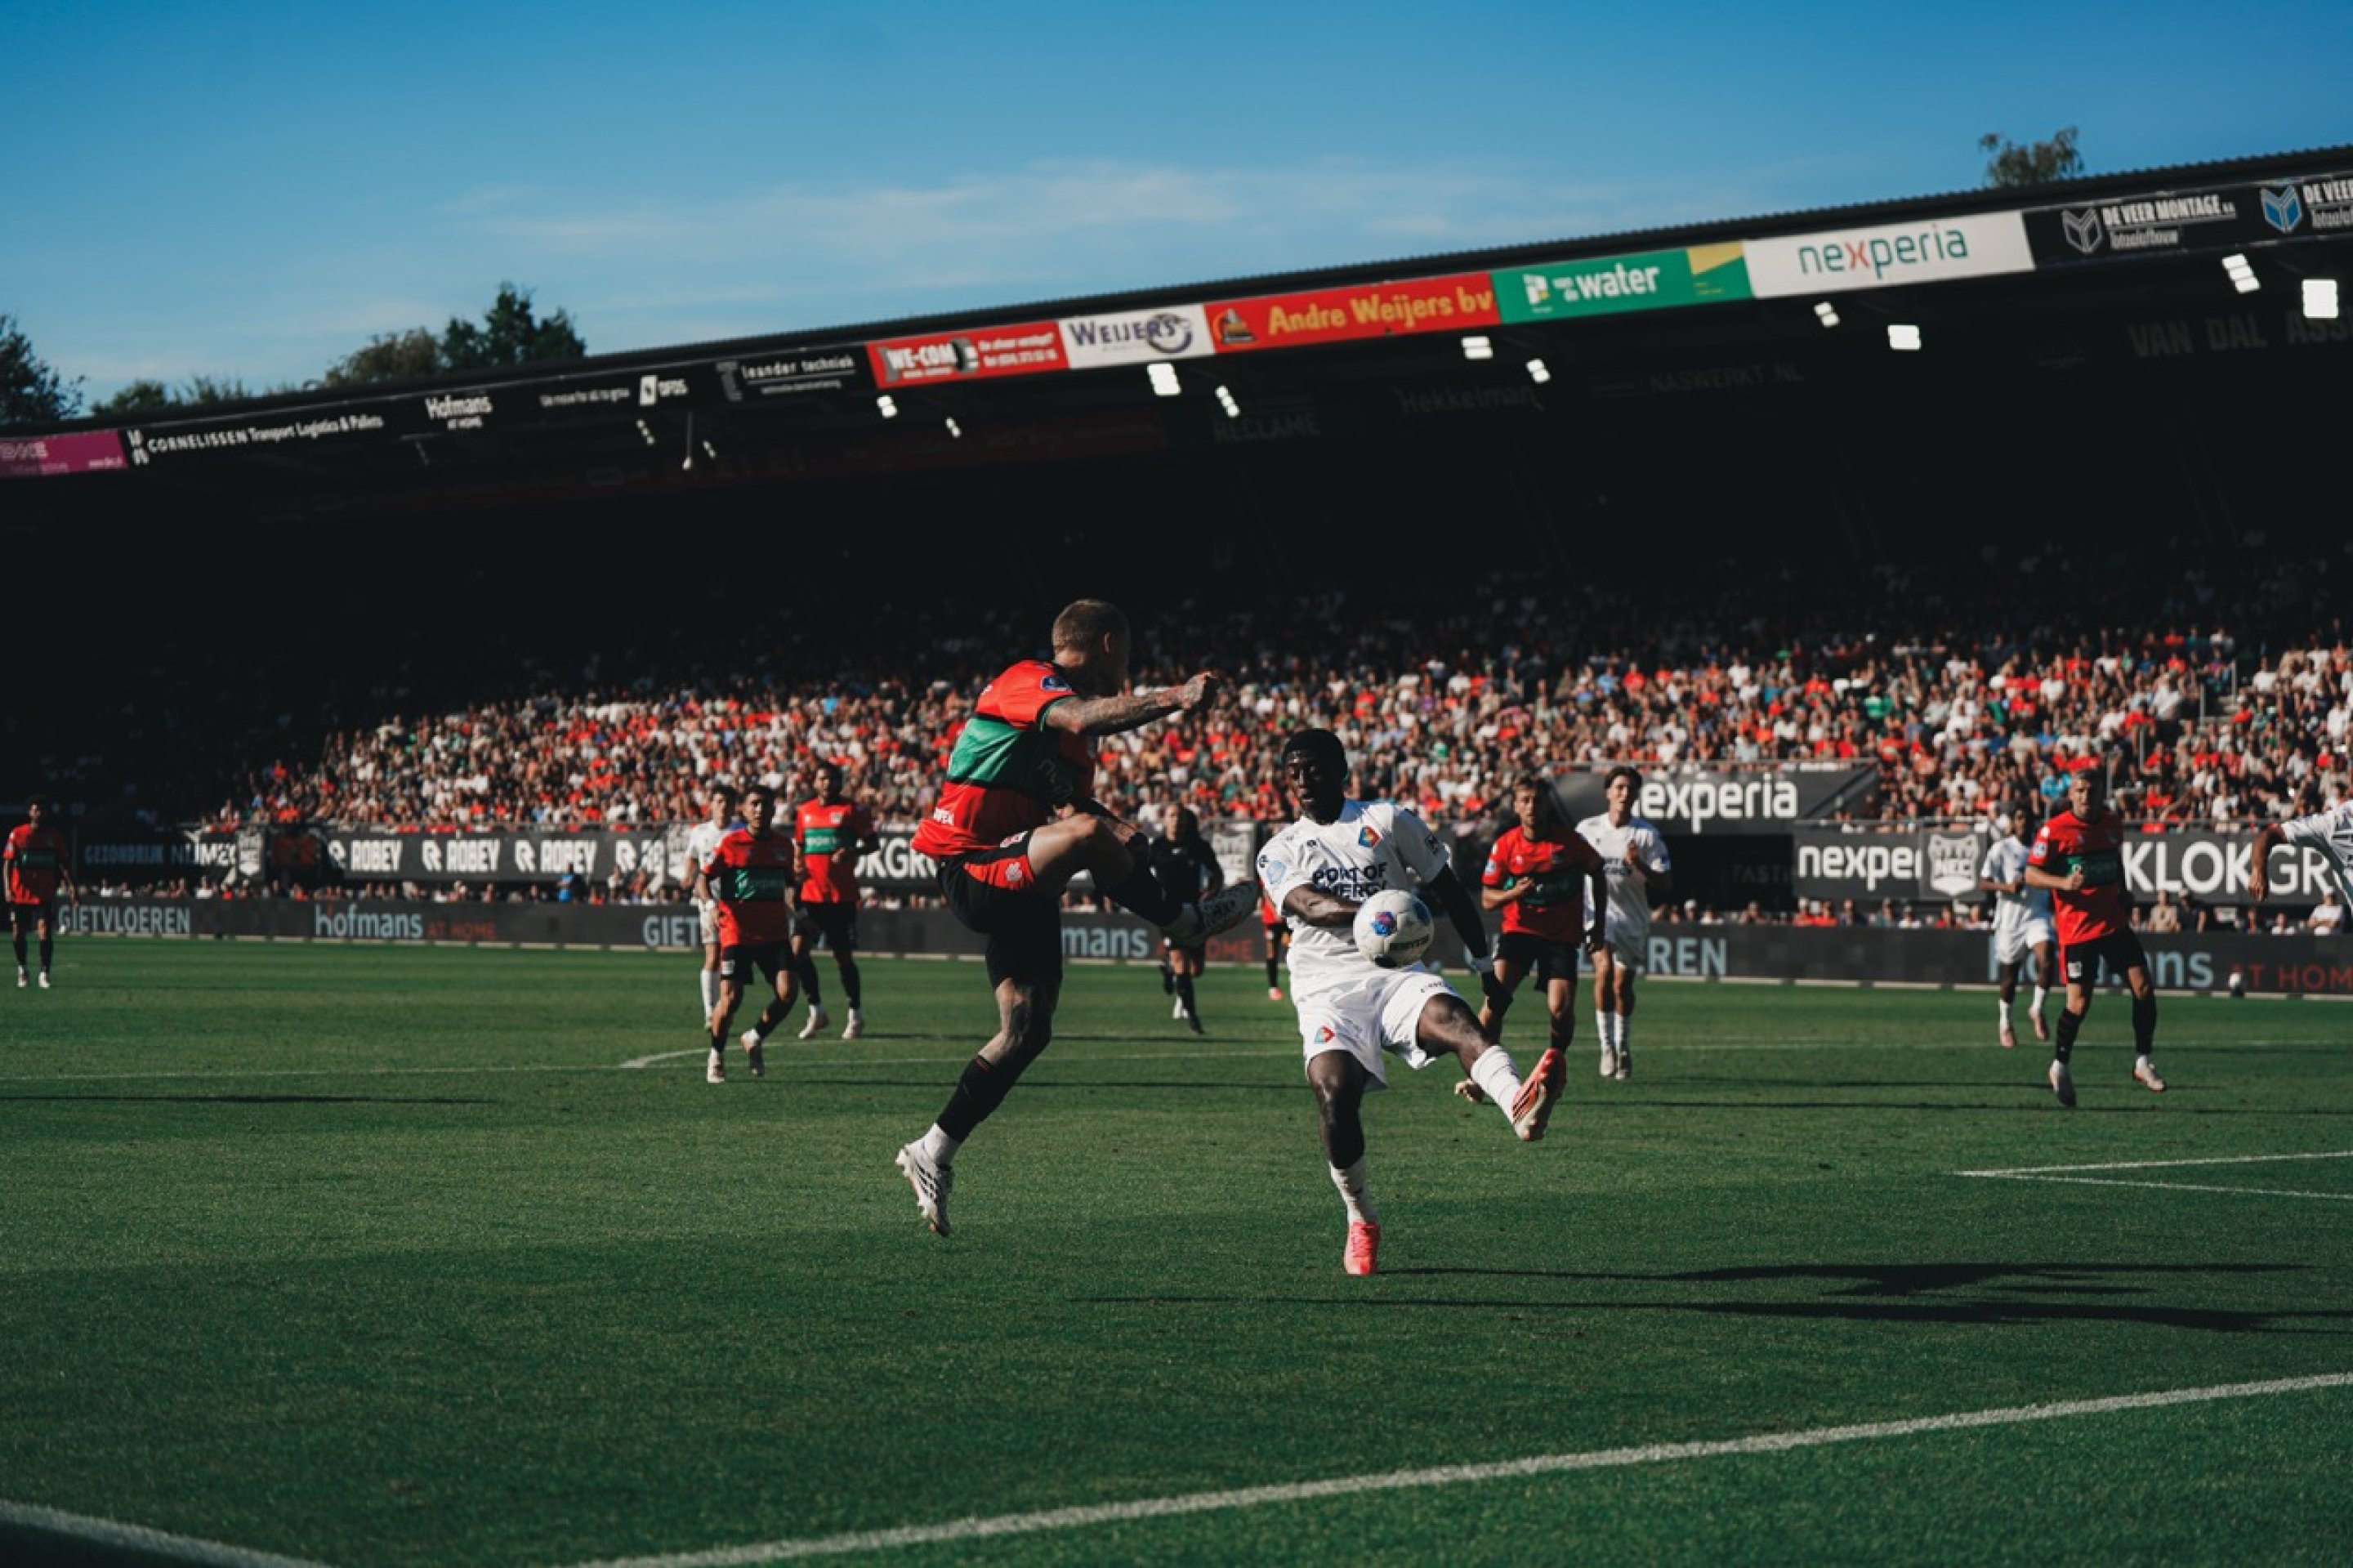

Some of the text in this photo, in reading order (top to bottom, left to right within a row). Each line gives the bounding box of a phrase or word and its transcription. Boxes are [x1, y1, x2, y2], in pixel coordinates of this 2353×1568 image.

[1800, 224, 1968, 279] nexperia
[1576, 262, 1660, 300] water
[1268, 286, 1494, 335] Andre Weijers bv
[2127, 321, 2193, 357] VAN
[2205, 313, 2268, 351] DAL
[147, 429, 248, 453] CORNELISSEN
[1636, 773, 1797, 833] experia
[58, 905, 190, 933] GIETVLOEREN
[314, 902, 423, 937] hofmans
[642, 915, 701, 947] GIET
[1060, 925, 1150, 958] mans
